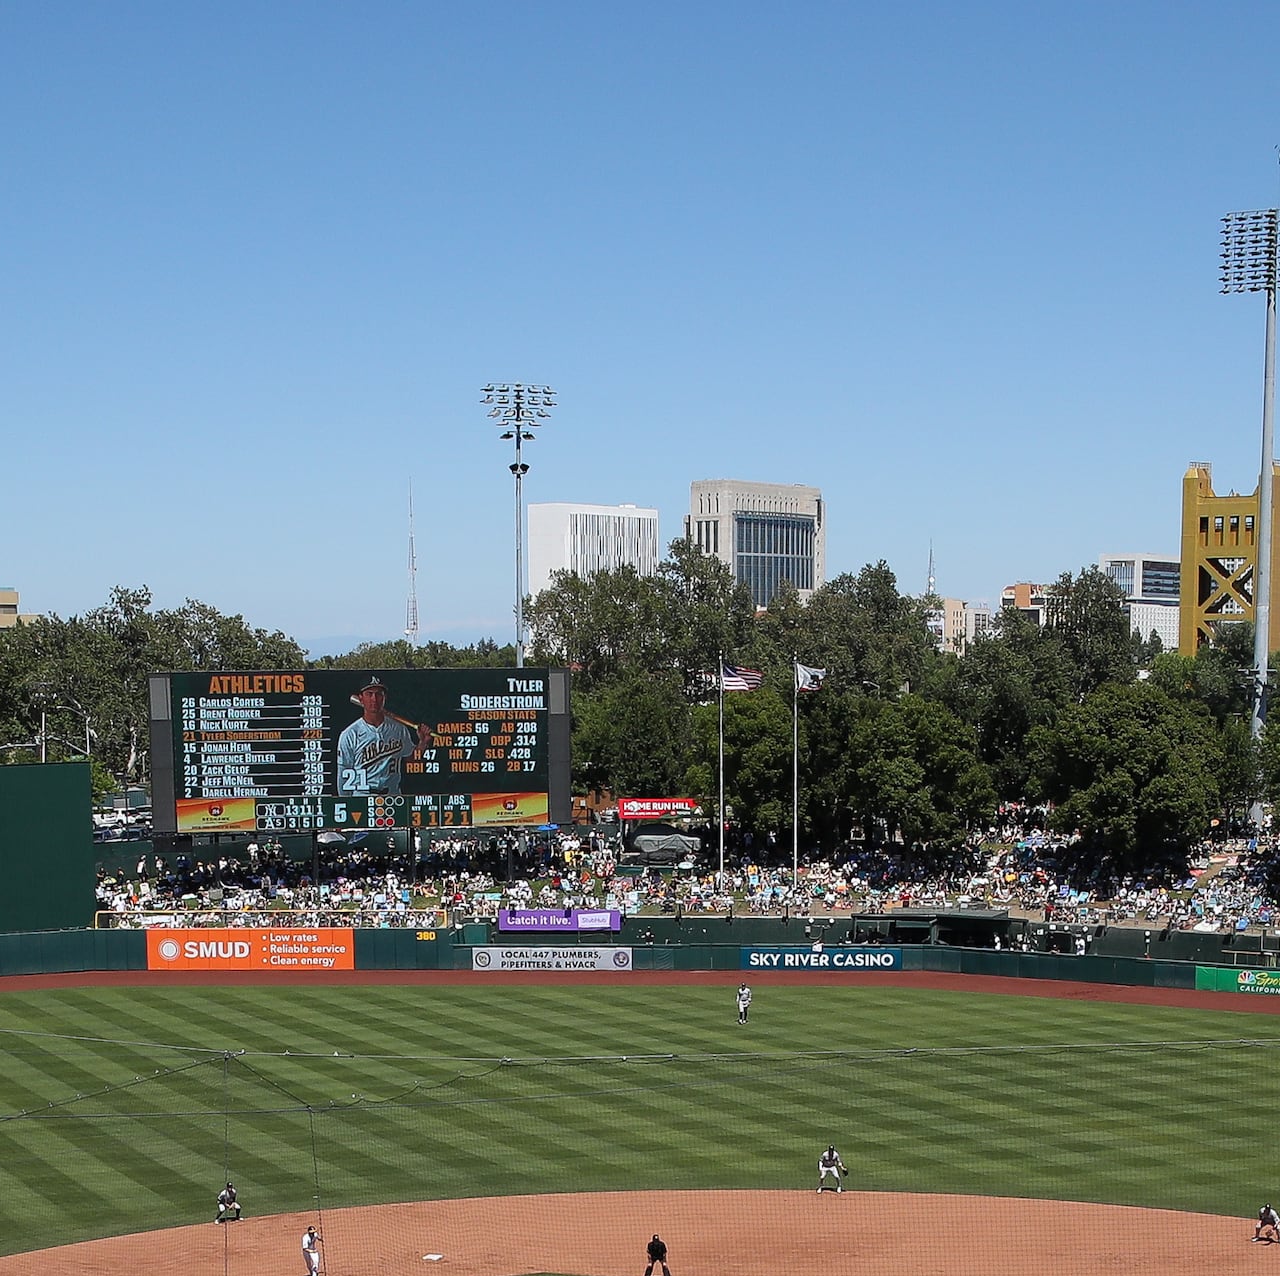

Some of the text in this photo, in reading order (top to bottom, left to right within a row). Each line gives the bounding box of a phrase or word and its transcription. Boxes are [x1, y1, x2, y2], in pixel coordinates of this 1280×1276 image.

[209, 675, 305, 694] ATHLETICS
[507, 677, 544, 693] TYLER
[181, 697, 196, 708] 26
[460, 694, 544, 709] SODERSTROM
[181, 709, 196, 719] 25
[468, 710, 537, 721] SEASON STATS
[182, 720, 196, 730] 16
[437, 723, 538, 734] GAMES 56 AB 208
[183, 732, 196, 741] 21
[433, 735, 537, 747] AVG .226 OBP .314
[183, 742, 196, 753] 15
[183, 754, 191, 764] 4
[414, 748, 531, 761] H 47 HR 7 SLG .428
[183, 765, 198, 776] 20
[406, 761, 536, 773] RBI 26 RUNS 26 2B 17
[184, 776, 198, 787] 22
[342, 768, 369, 791] 21
[184, 788, 192, 798] 2
[367, 797, 375, 806] B
[415, 795, 464, 806] MVR ABS
[652, 802, 671, 810] RUN
[672, 802, 690, 810] HILL
[286, 805, 323, 816] 13 11 1
[334, 803, 347, 823] 5
[368, 807, 375, 817] S
[288, 817, 324, 828] 3 5 0
[412, 812, 420, 825] 3
[429, 812, 437, 825] 1
[445, 811, 453, 825] 2
[461, 811, 469, 825] 1
[507, 914, 572, 925] Catch it live.
[184, 933, 318, 958] SMUD Low rates
[270, 944, 346, 954] Reliable service
[501, 951, 601, 960] LOCAL 447 PLUMBERS,
[749, 953, 894, 966] SKY RIVER CASINO
[270, 956, 335, 968] Clean energy
[500, 961, 552, 969] PIPEFITTERS
[555, 961, 562, 969] &
